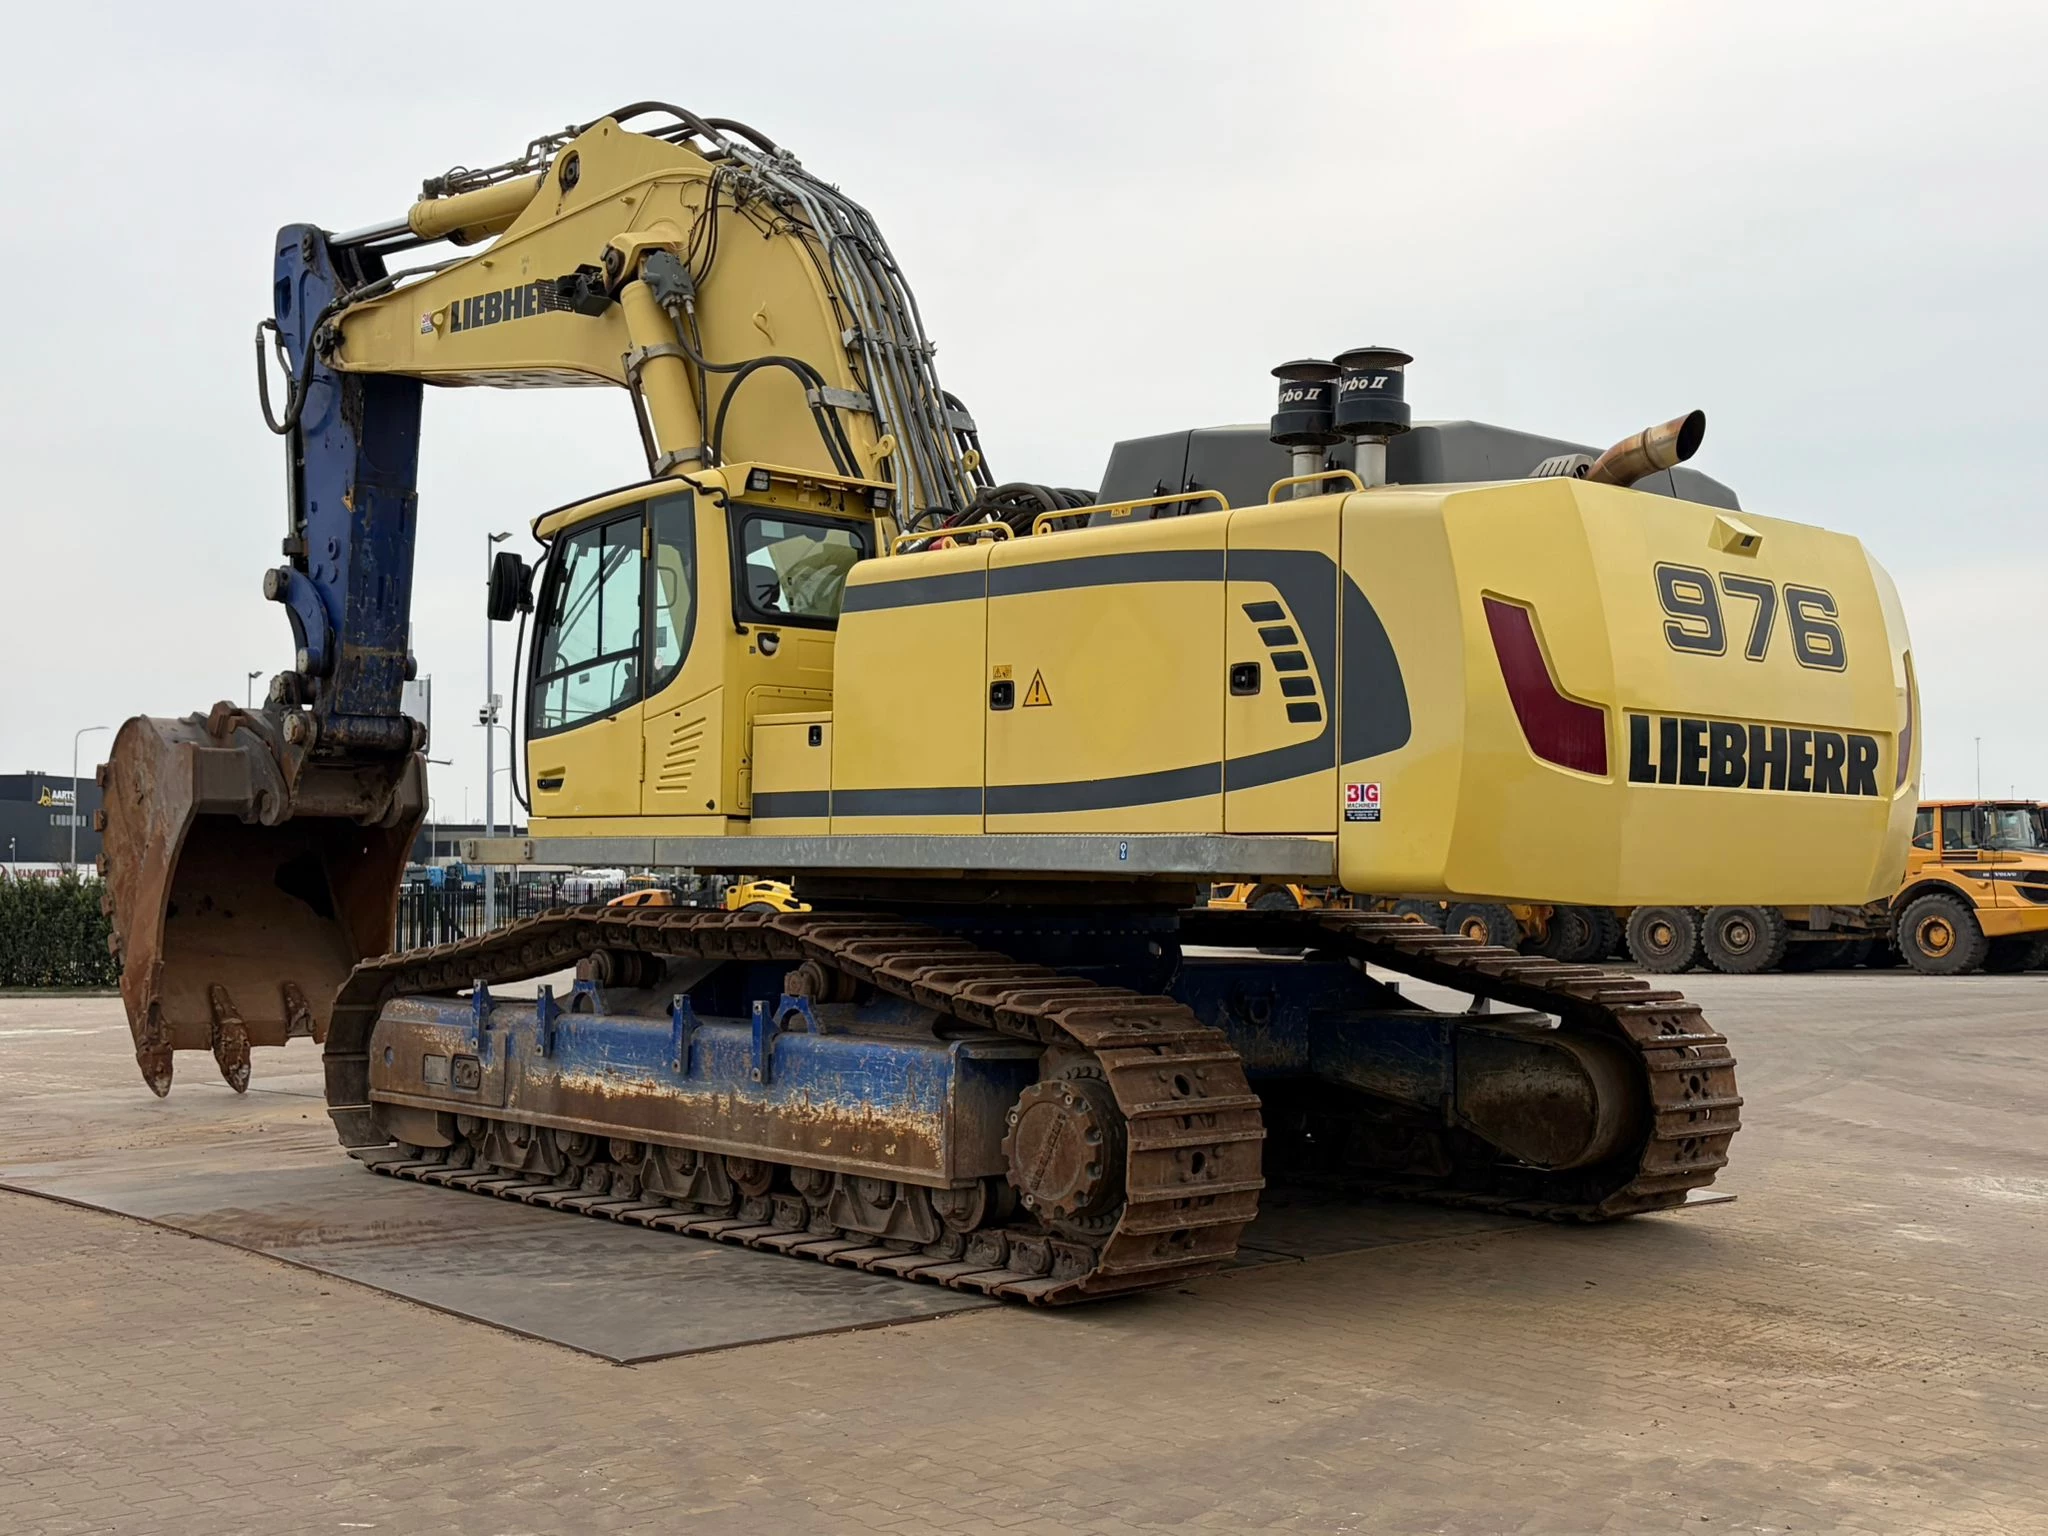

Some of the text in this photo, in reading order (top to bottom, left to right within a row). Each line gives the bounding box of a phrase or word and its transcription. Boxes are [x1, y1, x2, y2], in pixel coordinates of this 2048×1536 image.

[450, 281, 552, 333] LIEBHE
[1654, 561, 1848, 672] 976
[1629, 714, 1880, 796] LIEBHERR
